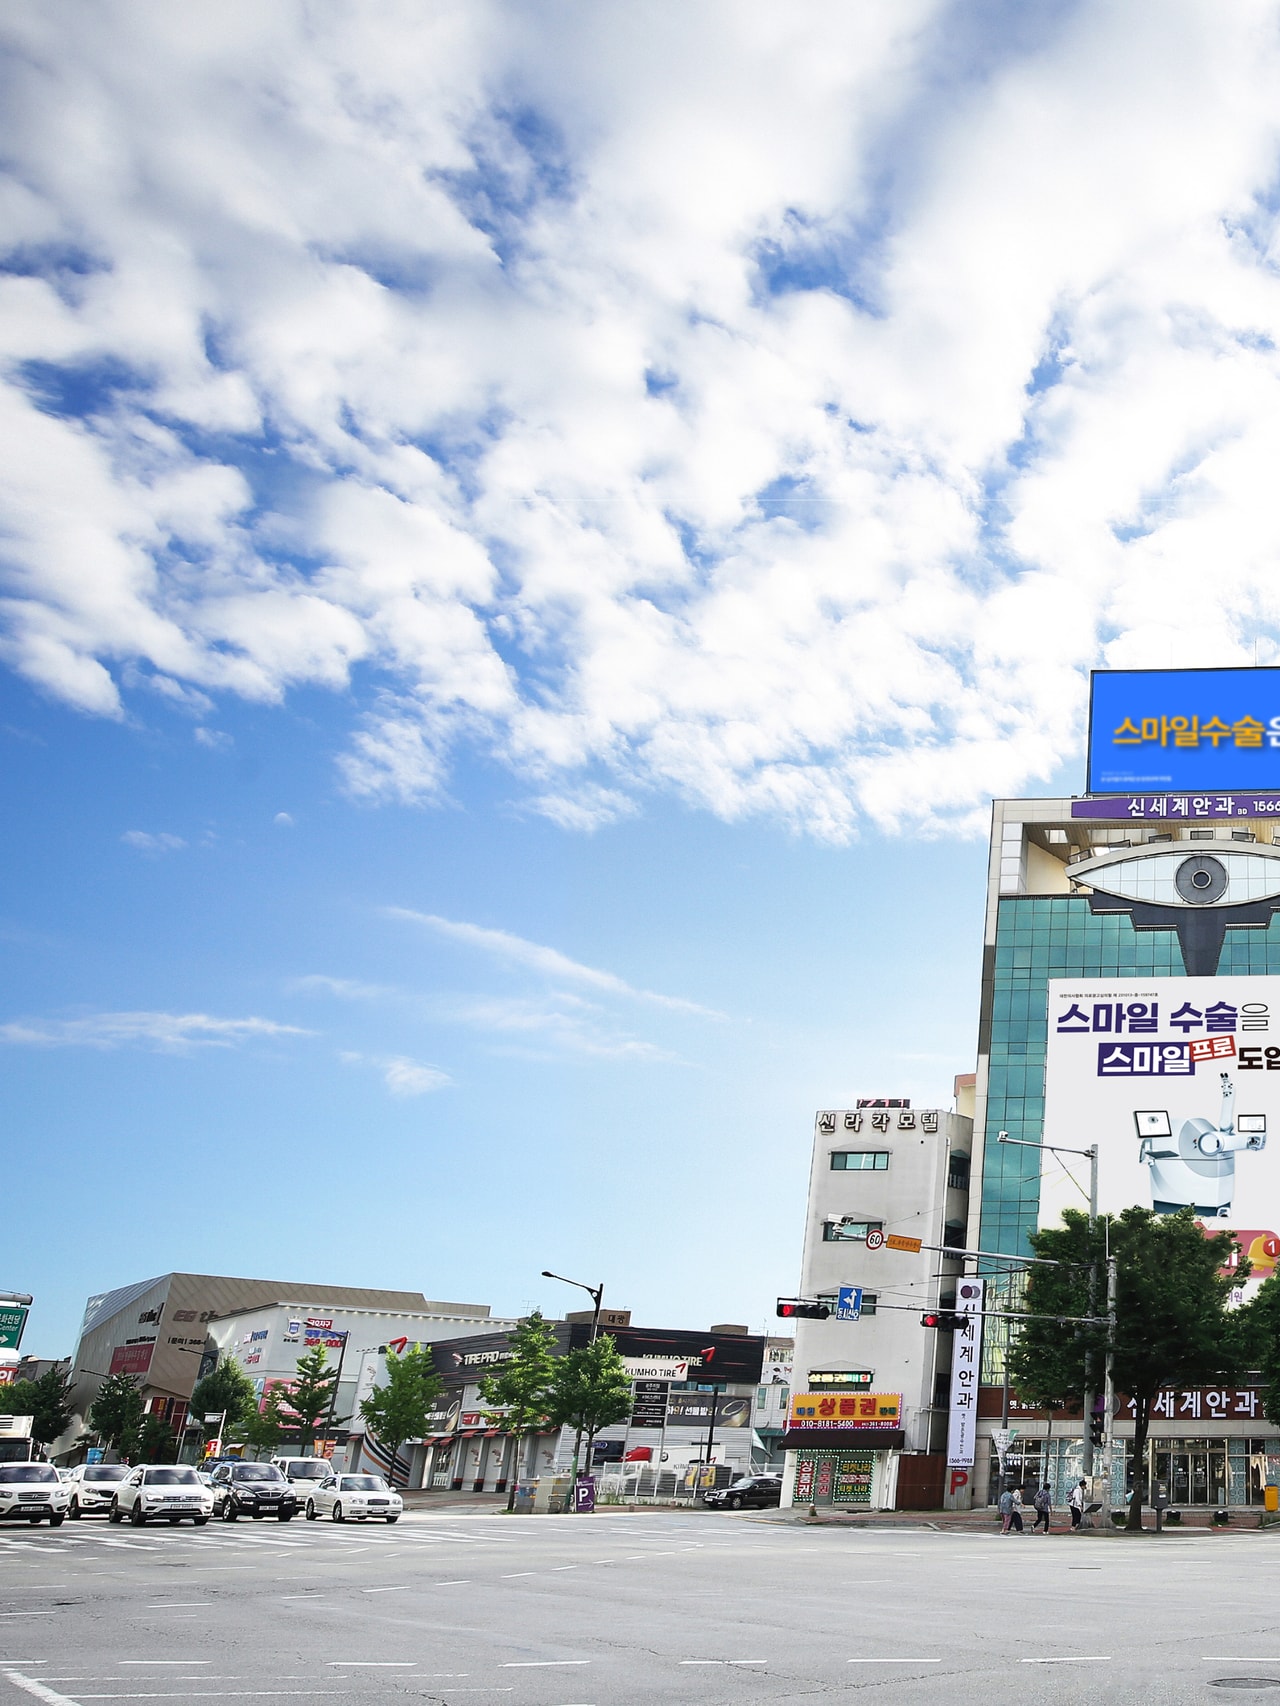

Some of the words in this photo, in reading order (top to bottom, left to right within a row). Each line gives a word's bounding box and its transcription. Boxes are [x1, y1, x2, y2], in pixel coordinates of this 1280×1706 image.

[1127, 796, 1235, 817] 신세계안과
[1057, 1002, 1159, 1033] 스마일
[1169, 1001, 1270, 1033] 수술을
[818, 1113, 938, 1132] 신라각모텔
[869, 1235, 880, 1244] 60
[956, 1304, 975, 1409] 신세계안과
[625, 1368, 657, 1376] KUMHO
[660, 1369, 677, 1377] TIRE
[818, 1398, 877, 1416] 상품권
[799, 1462, 813, 1495] 상품권
[950, 1472, 968, 1495] P
[579, 1488, 589, 1502] P
